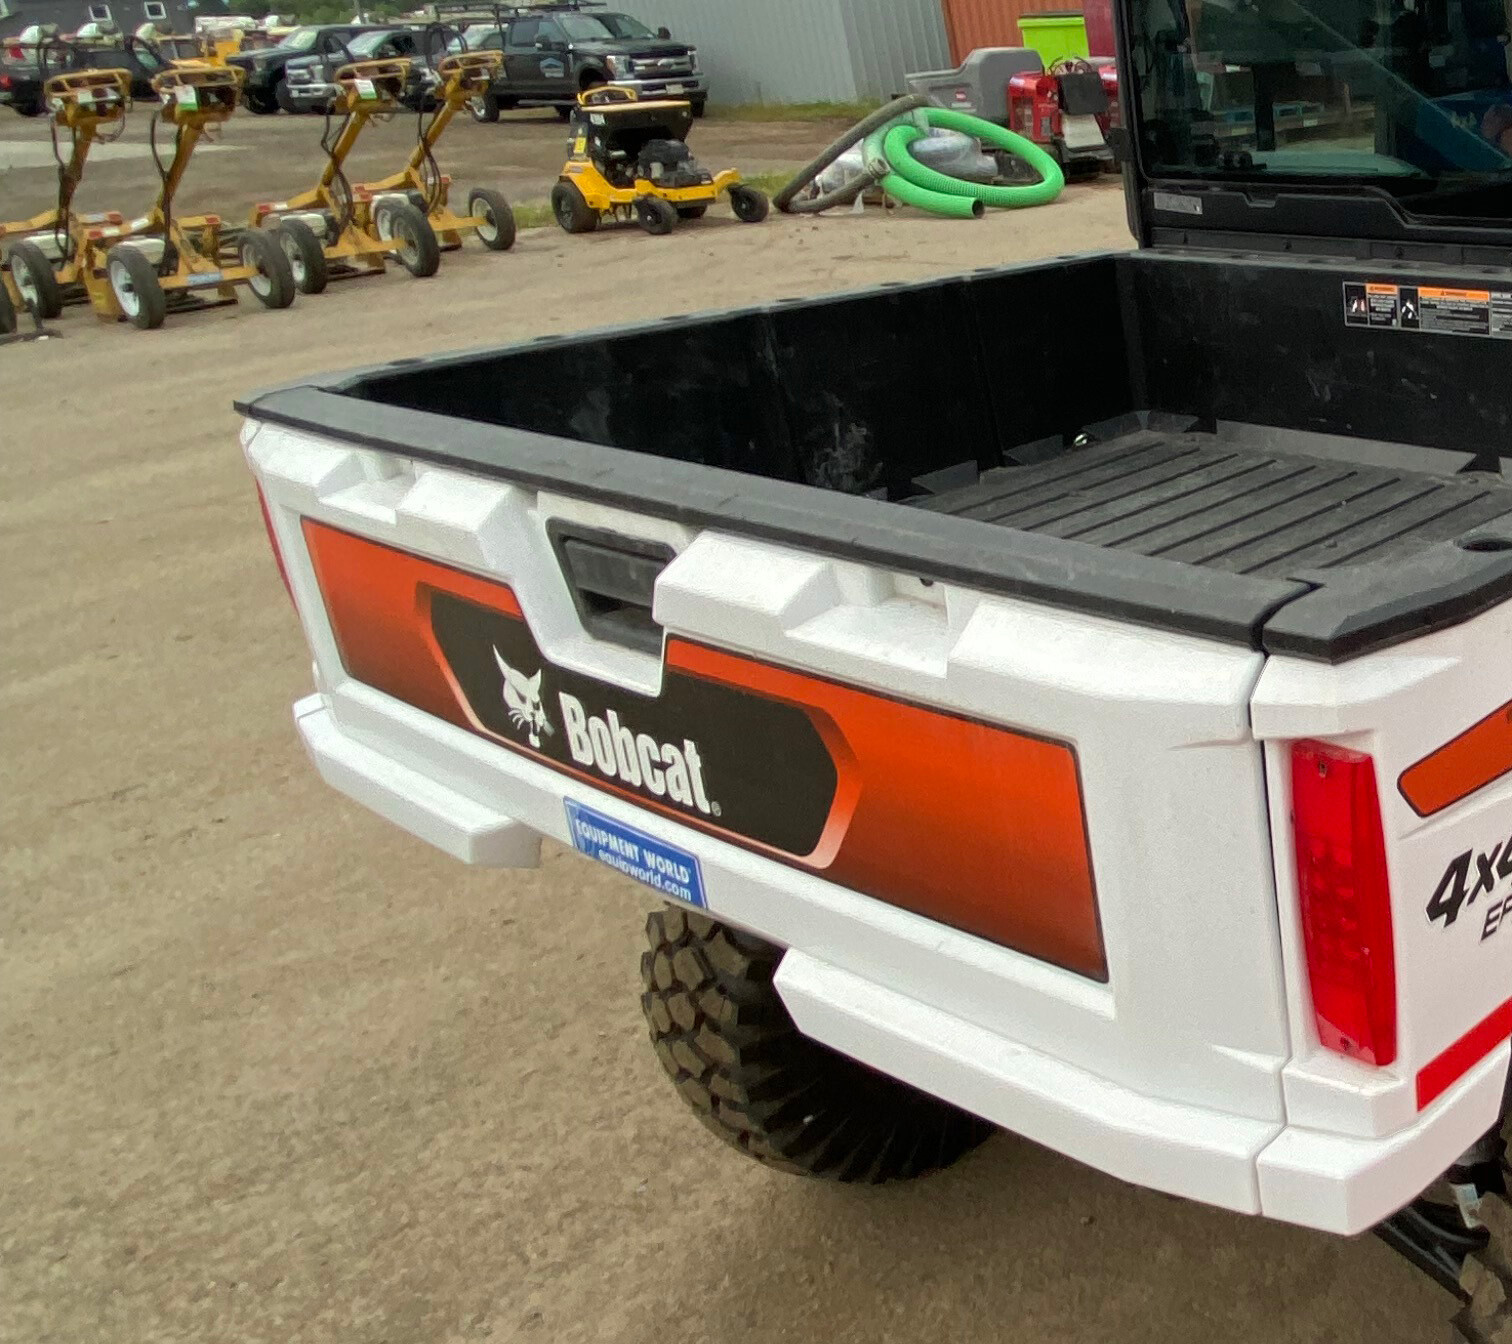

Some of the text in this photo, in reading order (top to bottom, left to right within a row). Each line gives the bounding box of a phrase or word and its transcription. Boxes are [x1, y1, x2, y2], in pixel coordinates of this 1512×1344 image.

[559, 692, 711, 814] Bobcat
[576, 819, 690, 884] EQUIPMENT WORLD
